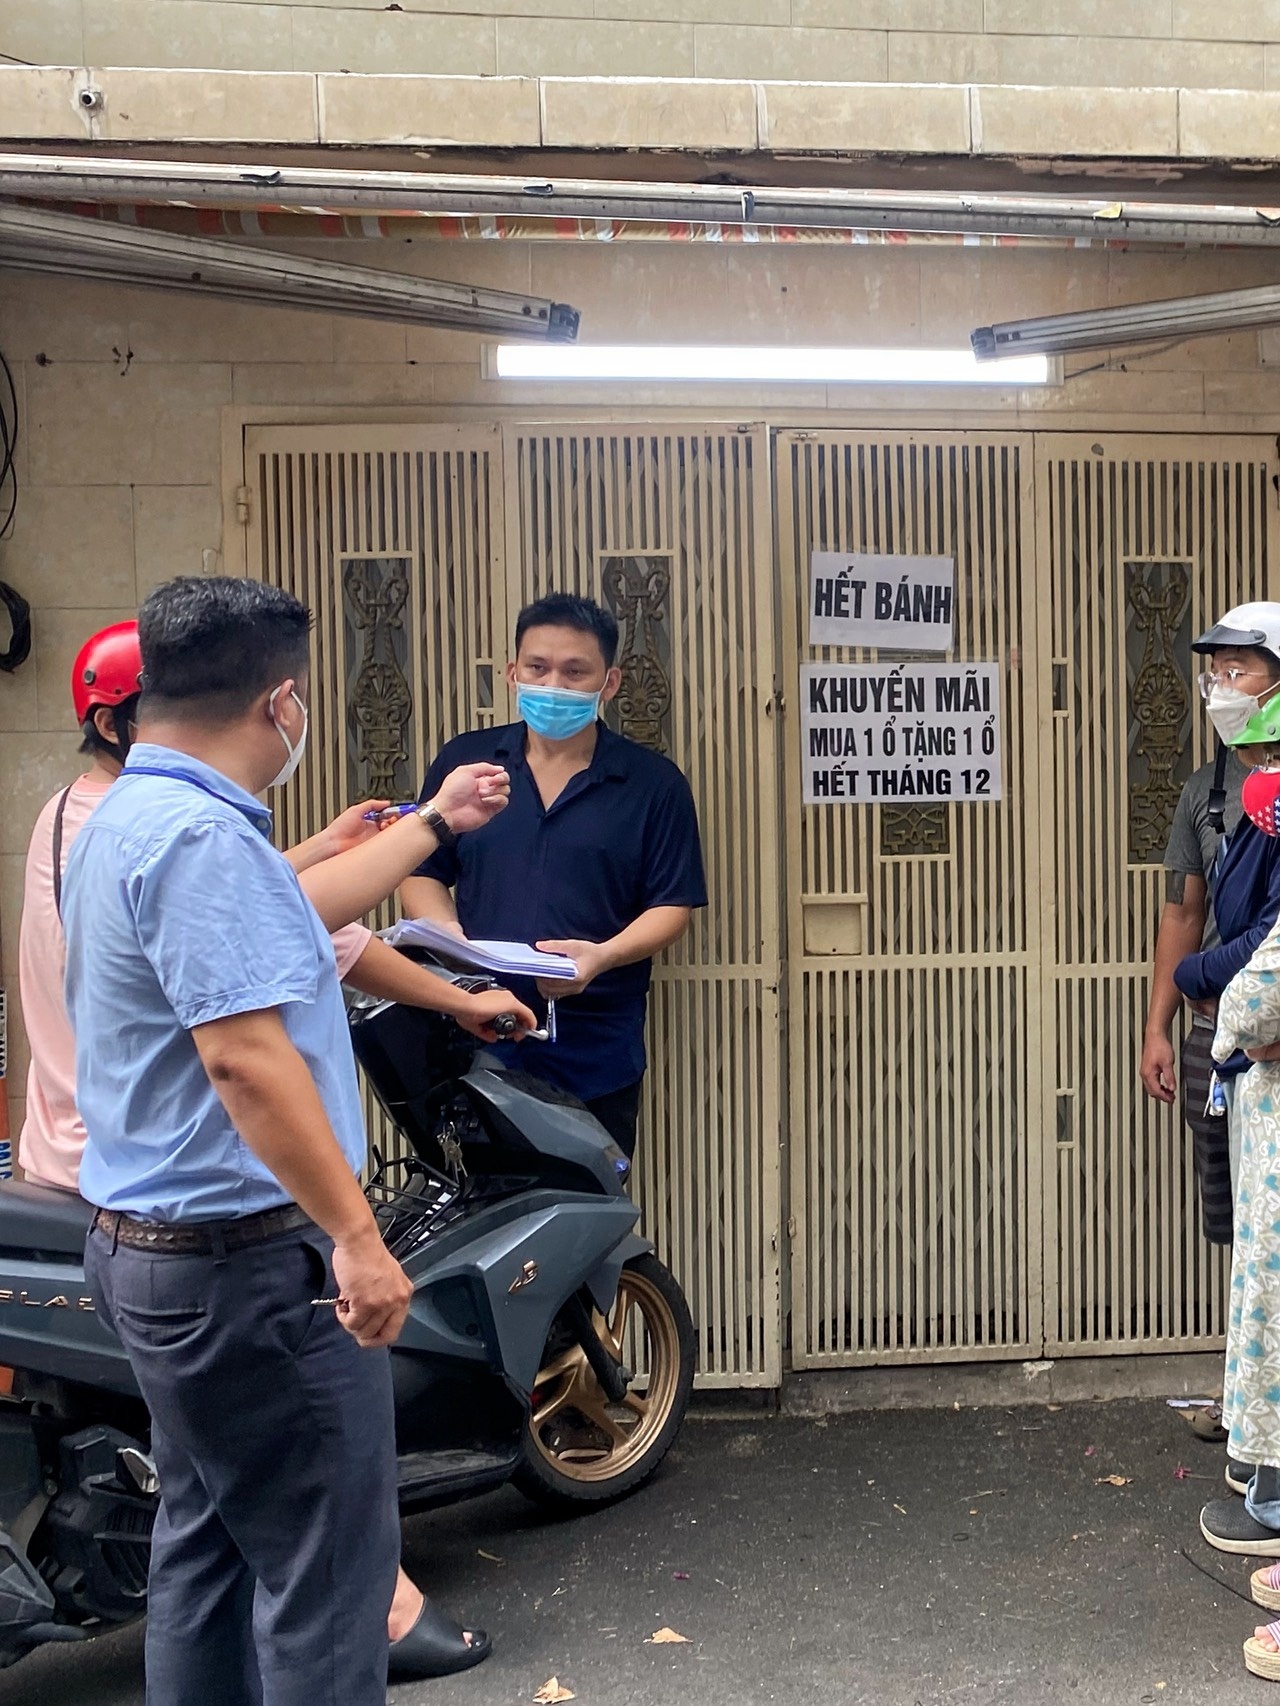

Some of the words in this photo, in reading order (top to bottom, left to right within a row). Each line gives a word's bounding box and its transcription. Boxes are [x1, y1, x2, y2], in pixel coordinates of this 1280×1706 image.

[815, 566, 867, 620] HẾT
[875, 575, 952, 624] BÁNH
[809, 664, 925, 713] KHUYẾN
[935, 669, 990, 713] MÃI
[810, 727, 857, 757] MUA
[864, 727, 873, 757] 1
[882, 715, 897, 757] Ổ
[902, 720, 956, 763] TẶNG
[963, 727, 972, 756] 1
[981, 714, 995, 756] Ổ
[813, 761, 859, 797] HẾT
[867, 764, 952, 796] THÁNG
[961, 768, 991, 795] 12
